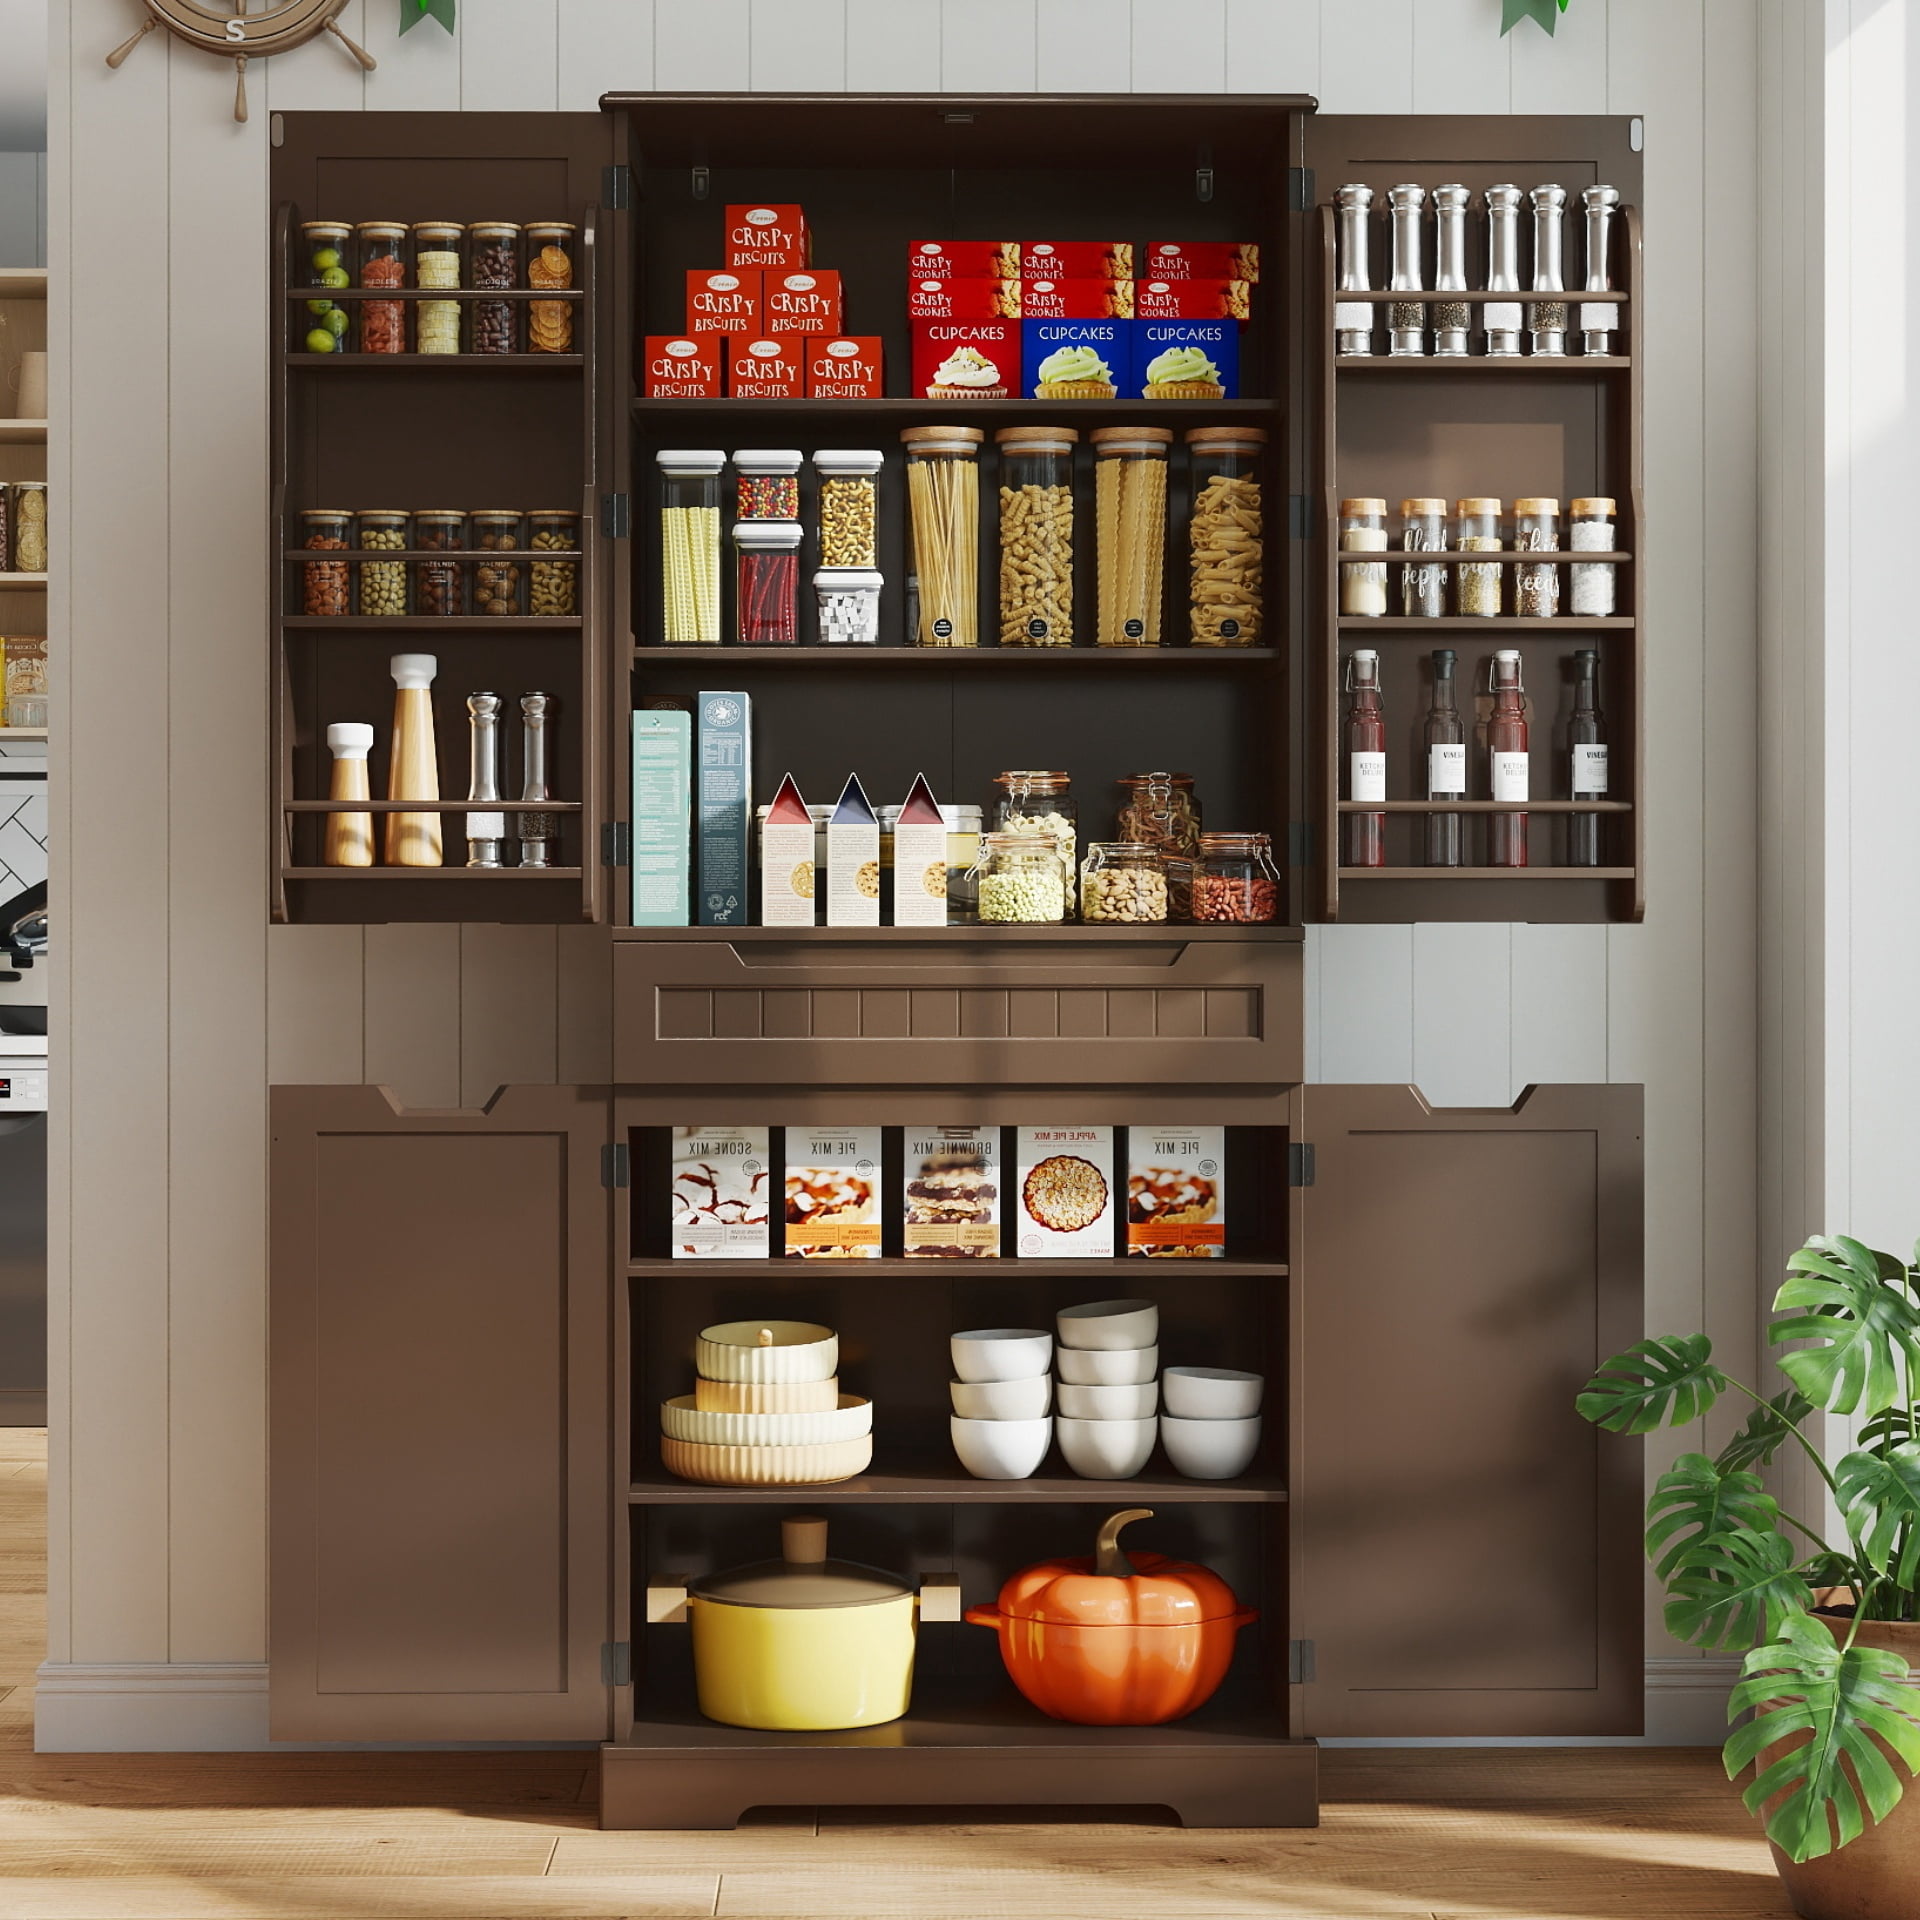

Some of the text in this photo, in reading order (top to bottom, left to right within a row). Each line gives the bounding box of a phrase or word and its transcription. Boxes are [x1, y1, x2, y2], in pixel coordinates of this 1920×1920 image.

[226, 20, 244, 42] S
[732, 227, 792, 249] CRISPY
[733, 251, 786, 266] BISCUITS
[912, 256, 952, 270] CRISPY
[1024, 256, 1064, 271] CRISPY
[1151, 256, 1190, 271] CRISPY
[912, 270, 952, 278] COOKIES
[1024, 270, 1064, 279] COOKIES
[1151, 270, 1191, 280] COOKIES
[694, 293, 754, 315] CRISPY
[770, 293, 831, 315] CRISPY
[912, 293, 952, 307] CRISPY
[1025, 293, 1065, 307] CRISPY
[1140, 294, 1180, 308] CRISPY
[912, 306, 952, 317] COOKIES
[1025, 306, 1065, 317] COOKIES
[1140, 307, 1180, 317] COOKIES
[695, 316, 747, 332] BISCUITS
[772, 316, 824, 332] BISCUITS
[929, 326, 1004, 340] CUPCAKES
[1039, 326, 1114, 340] CUPCAKES
[1147, 327, 1222, 341] CUPCAKES
[652, 359, 712, 381] CRISPY
[736, 359, 796, 381] CRISPY
[813, 359, 874, 381] CRISPY
[653, 382, 705, 398] BISCUITS
[737, 382, 789, 398] BISCUITS
[814, 382, 866, 398] BISCUITS
